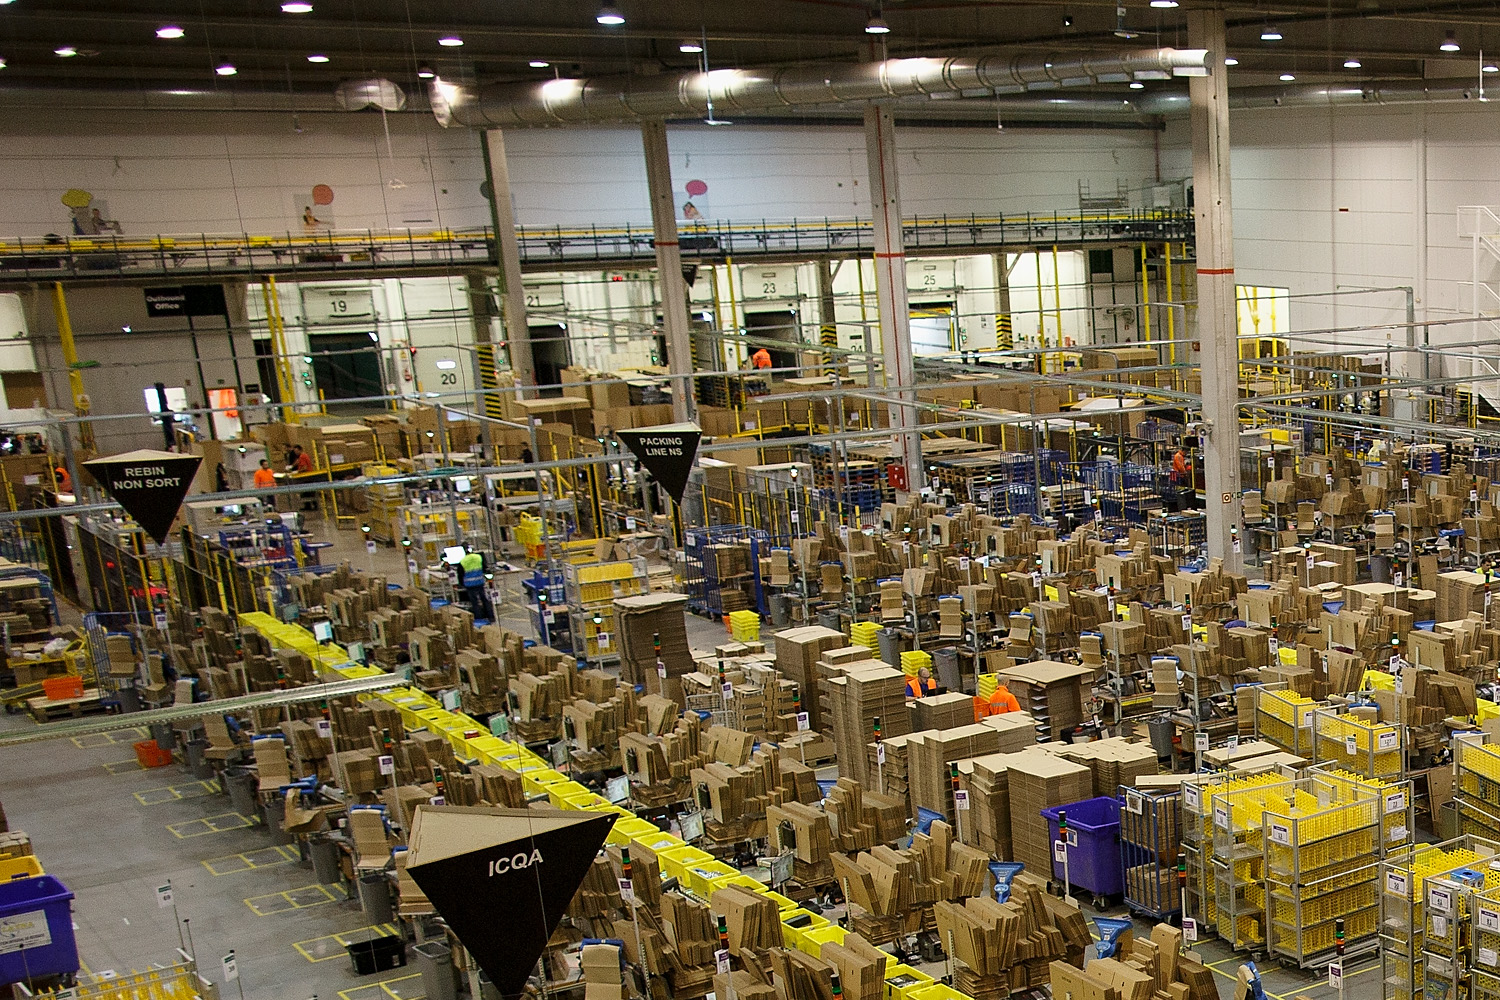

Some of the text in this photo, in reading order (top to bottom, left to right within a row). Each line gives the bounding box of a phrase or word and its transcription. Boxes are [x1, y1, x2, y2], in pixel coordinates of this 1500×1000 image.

[924, 275, 936, 285] 25
[763, 283, 776, 294] 23
[331, 300, 347, 313] 19
[527, 295, 541, 307] 21
[441, 374, 457, 385] 20
[640, 438, 682, 446] PACKING
[646, 447, 682, 456] LINE NS
[125, 467, 165, 478] REBIN
[114, 478, 181, 489] NON SORT
[487, 848, 544, 878] ICQA
